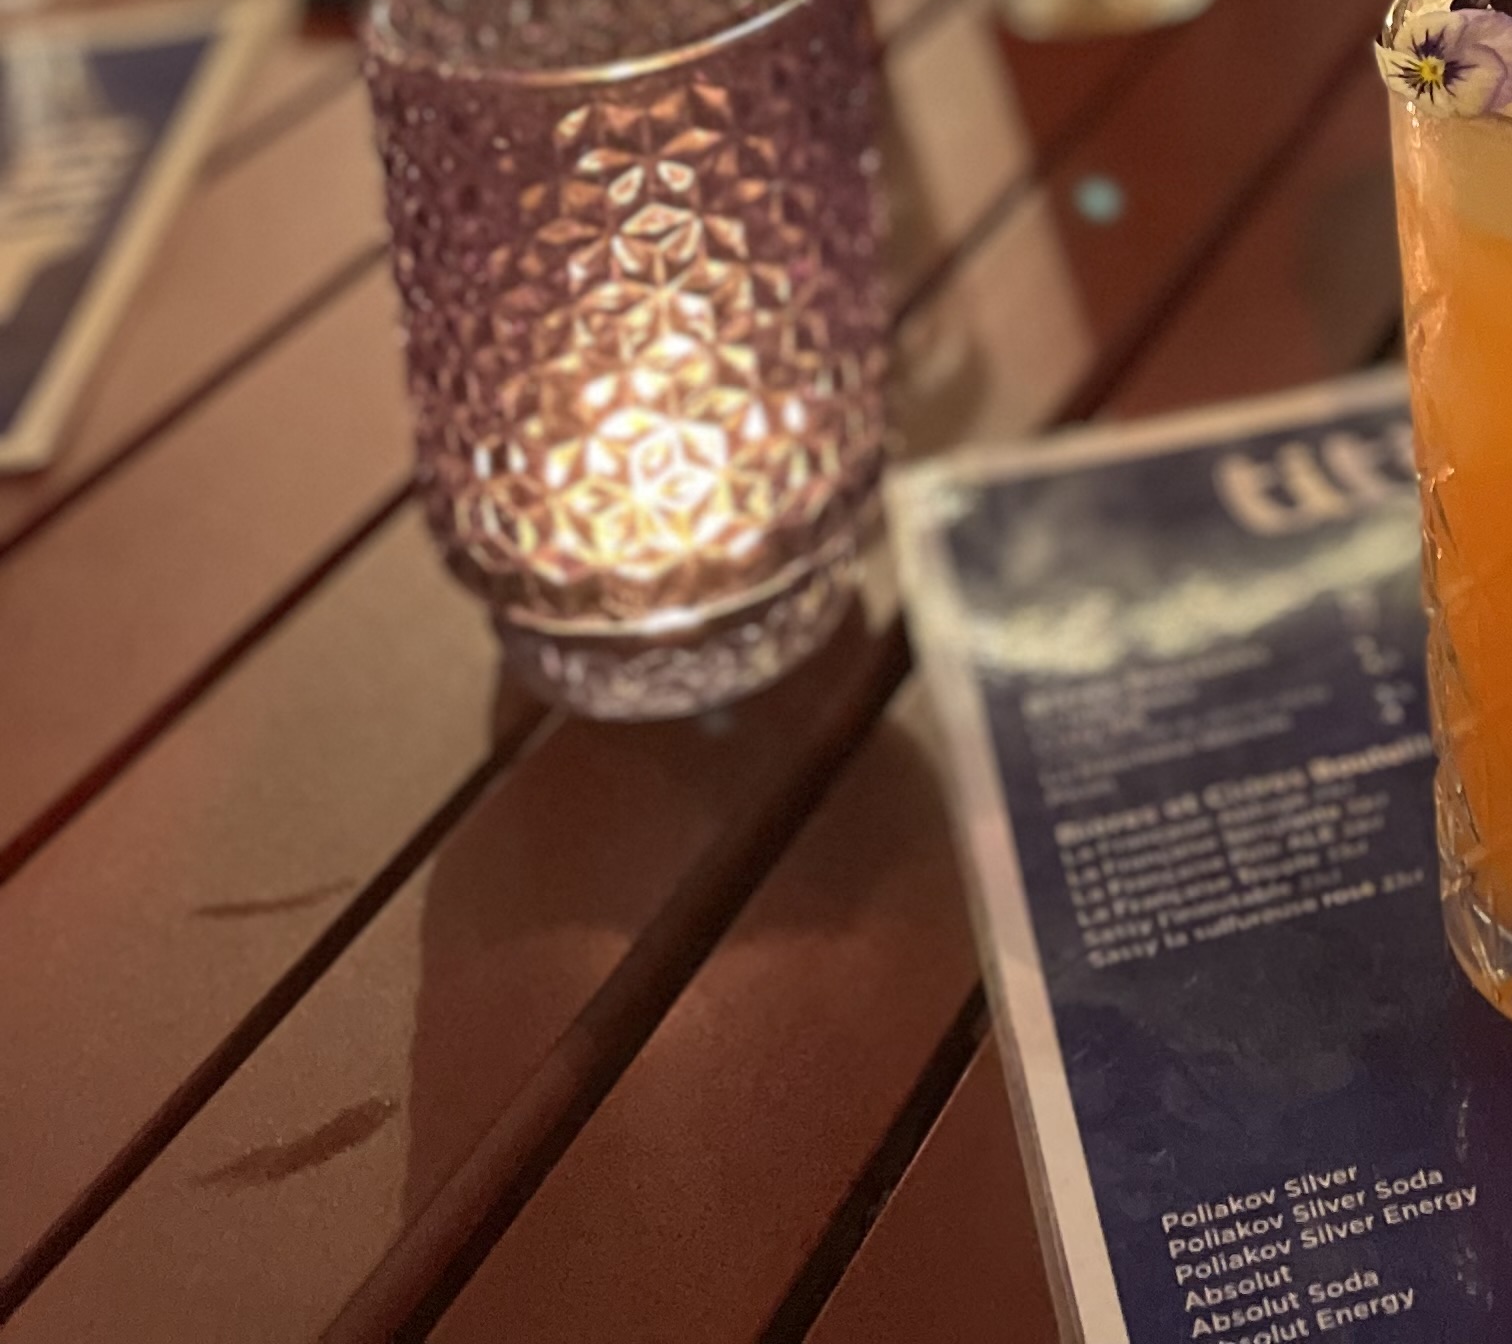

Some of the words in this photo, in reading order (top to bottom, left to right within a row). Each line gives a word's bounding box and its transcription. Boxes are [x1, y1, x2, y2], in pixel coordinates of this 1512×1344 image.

[1162, 1187, 1277, 1234] Poliakov
[1284, 1163, 1359, 1200] Silver
[1168, 1213, 1285, 1260] Poliakov
[1292, 1190, 1367, 1224] Silver
[1374, 1167, 1444, 1201] Soda
[1175, 1237, 1293, 1286] Poliakov
[1300, 1213, 1375, 1250] Silver
[1381, 1184, 1479, 1226] Energy
[1184, 1264, 1294, 1313] Absolut
[1191, 1291, 1301, 1340] Absolut
[1307, 1268, 1381, 1304] Soda
[1315, 1287, 1416, 1332] Energy
